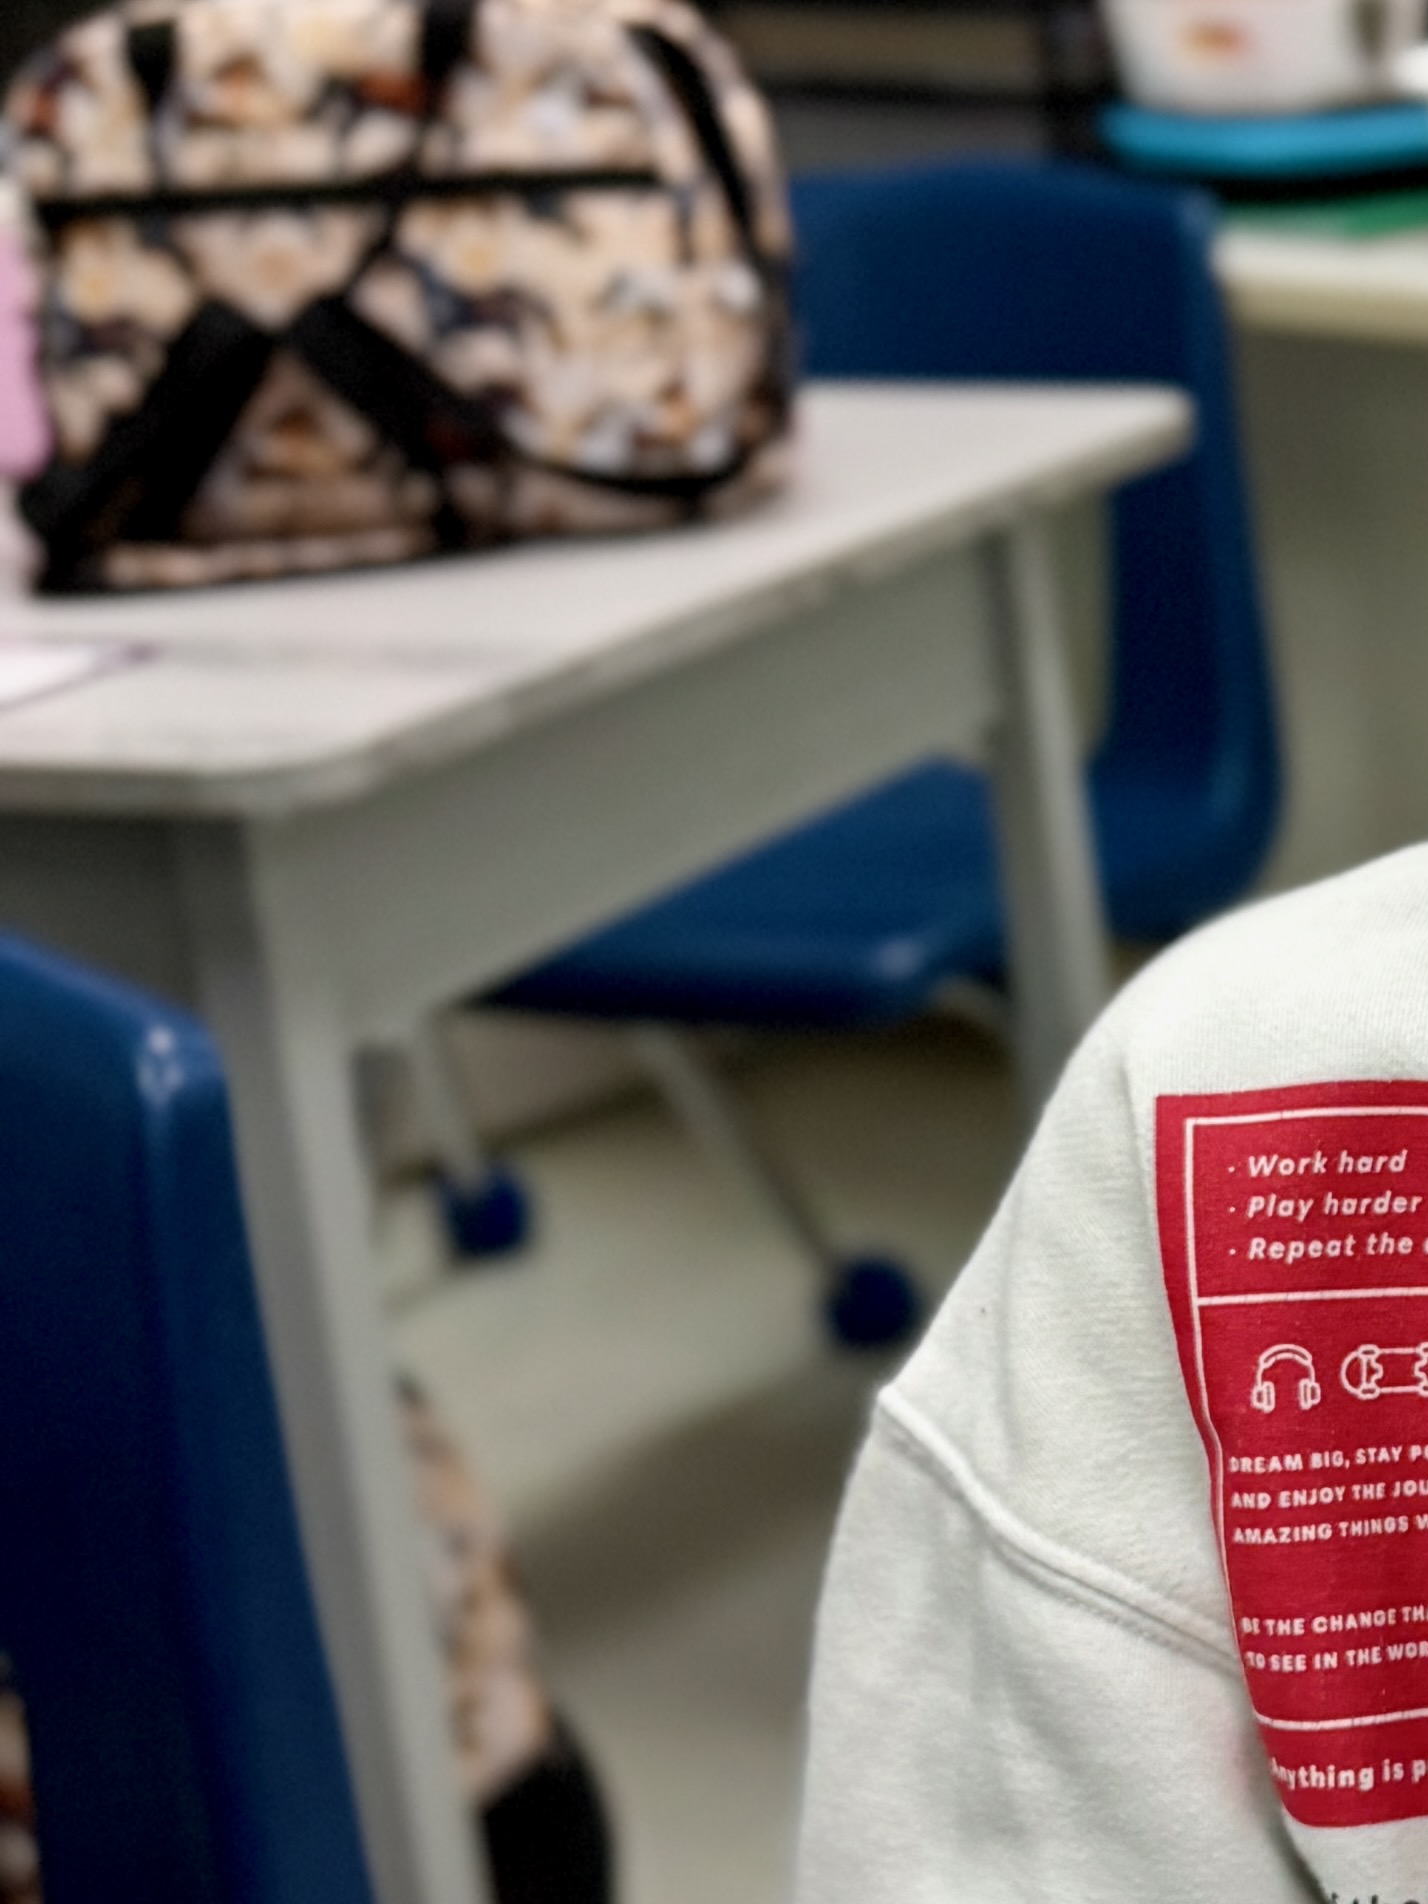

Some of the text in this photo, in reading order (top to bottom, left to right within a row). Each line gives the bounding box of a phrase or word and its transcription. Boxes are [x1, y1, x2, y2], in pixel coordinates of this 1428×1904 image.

[1248, 1148, 1408, 1177] Work hard
[1247, 1189, 1422, 1222] Play harder
[1248, 1234, 1356, 1264] Repeat
[1366, 1232, 1413, 1256] the
[1229, 1453, 1304, 1474] DREAM
[1310, 1451, 1350, 1469] BIG,
[1355, 1445, 1402, 1465] STAY
[1231, 1492, 1271, 1509] AND
[1278, 1486, 1345, 1508] ENJOY
[1352, 1482, 1386, 1500] THE
[1233, 1523, 1332, 1544] AMAZING
[1338, 1516, 1409, 1538] THINGS
[1240, 1617, 1260, 1636] BE
[1263, 1617, 1305, 1636] THE
[1311, 1607, 1397, 1634] CHANGE
[1245, 1651, 1266, 1669] TO
[1269, 1653, 1307, 1672] SEE
[1313, 1651, 1338, 1669] IN
[1345, 1646, 1382, 1667] THE
[1382, 1758, 1404, 1782] is
